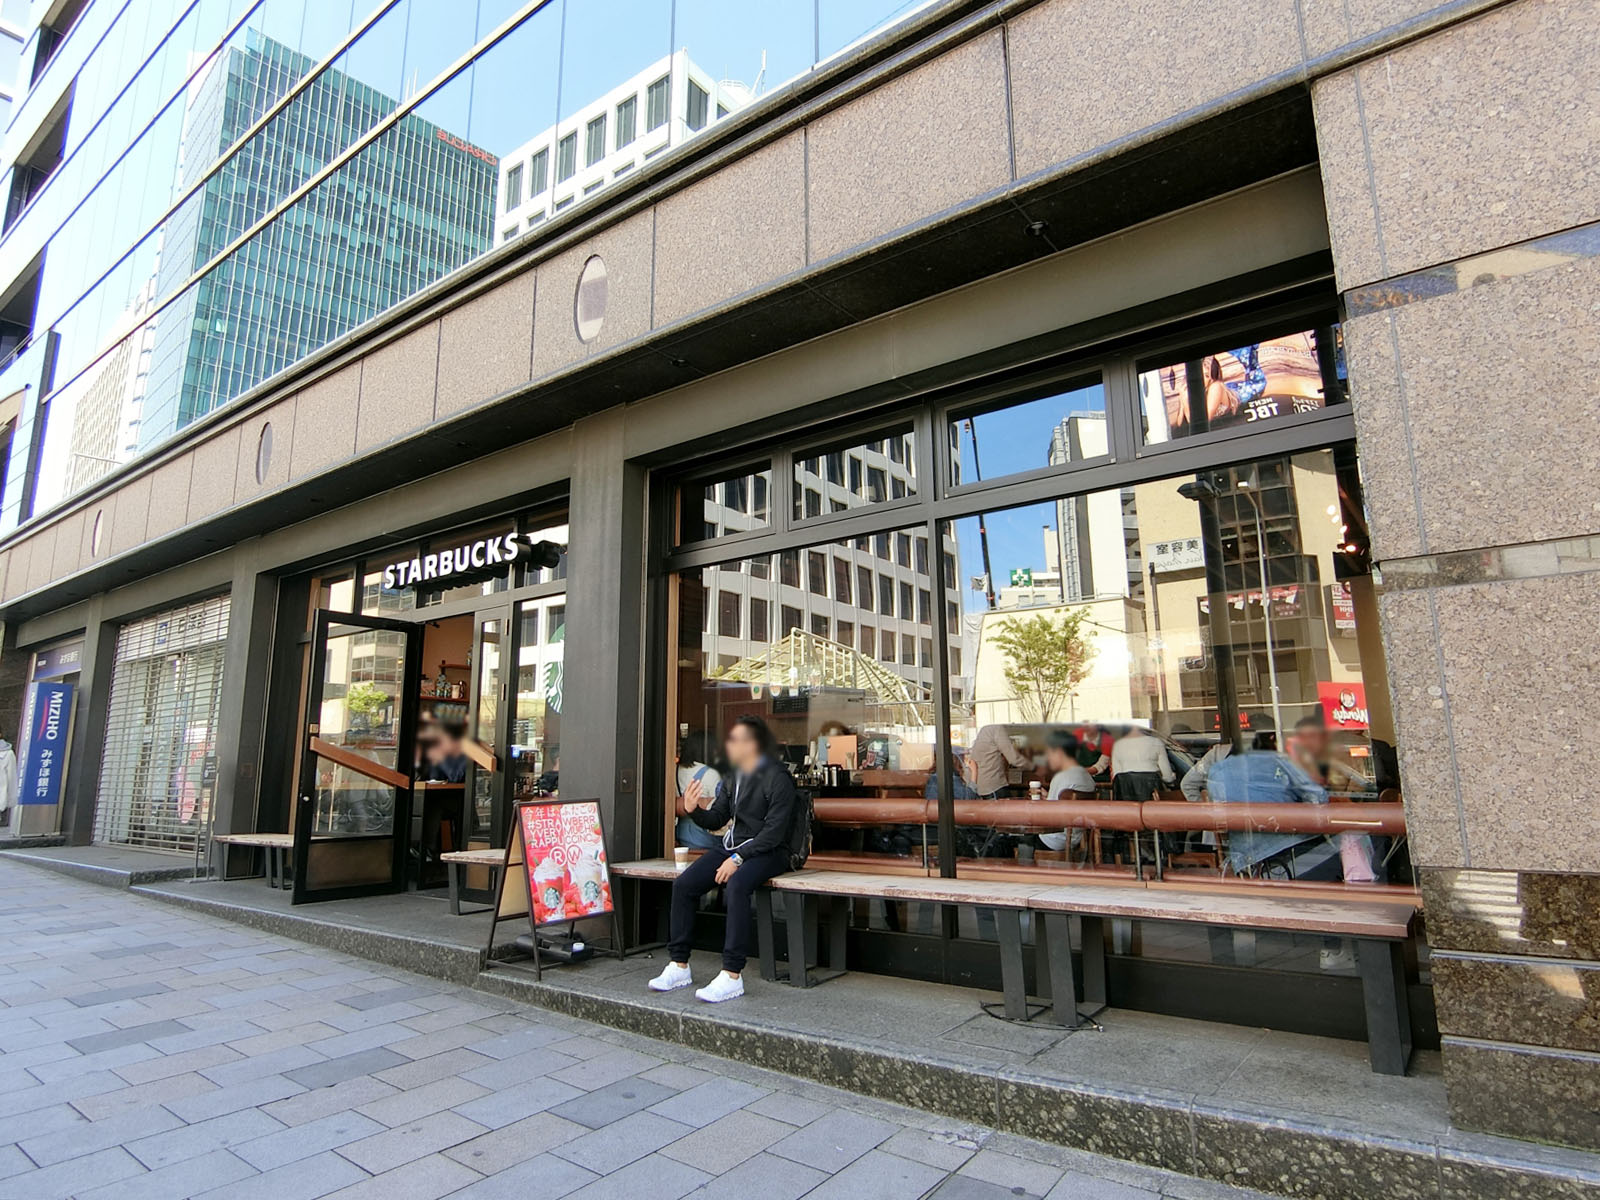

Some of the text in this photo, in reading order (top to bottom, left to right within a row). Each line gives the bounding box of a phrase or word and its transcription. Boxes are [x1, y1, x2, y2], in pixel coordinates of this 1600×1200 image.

[384, 532, 519, 589] STARBUCKS
[46, 691, 64, 740] MIZUHO
[36, 749, 53, 797] みずほ銀行
